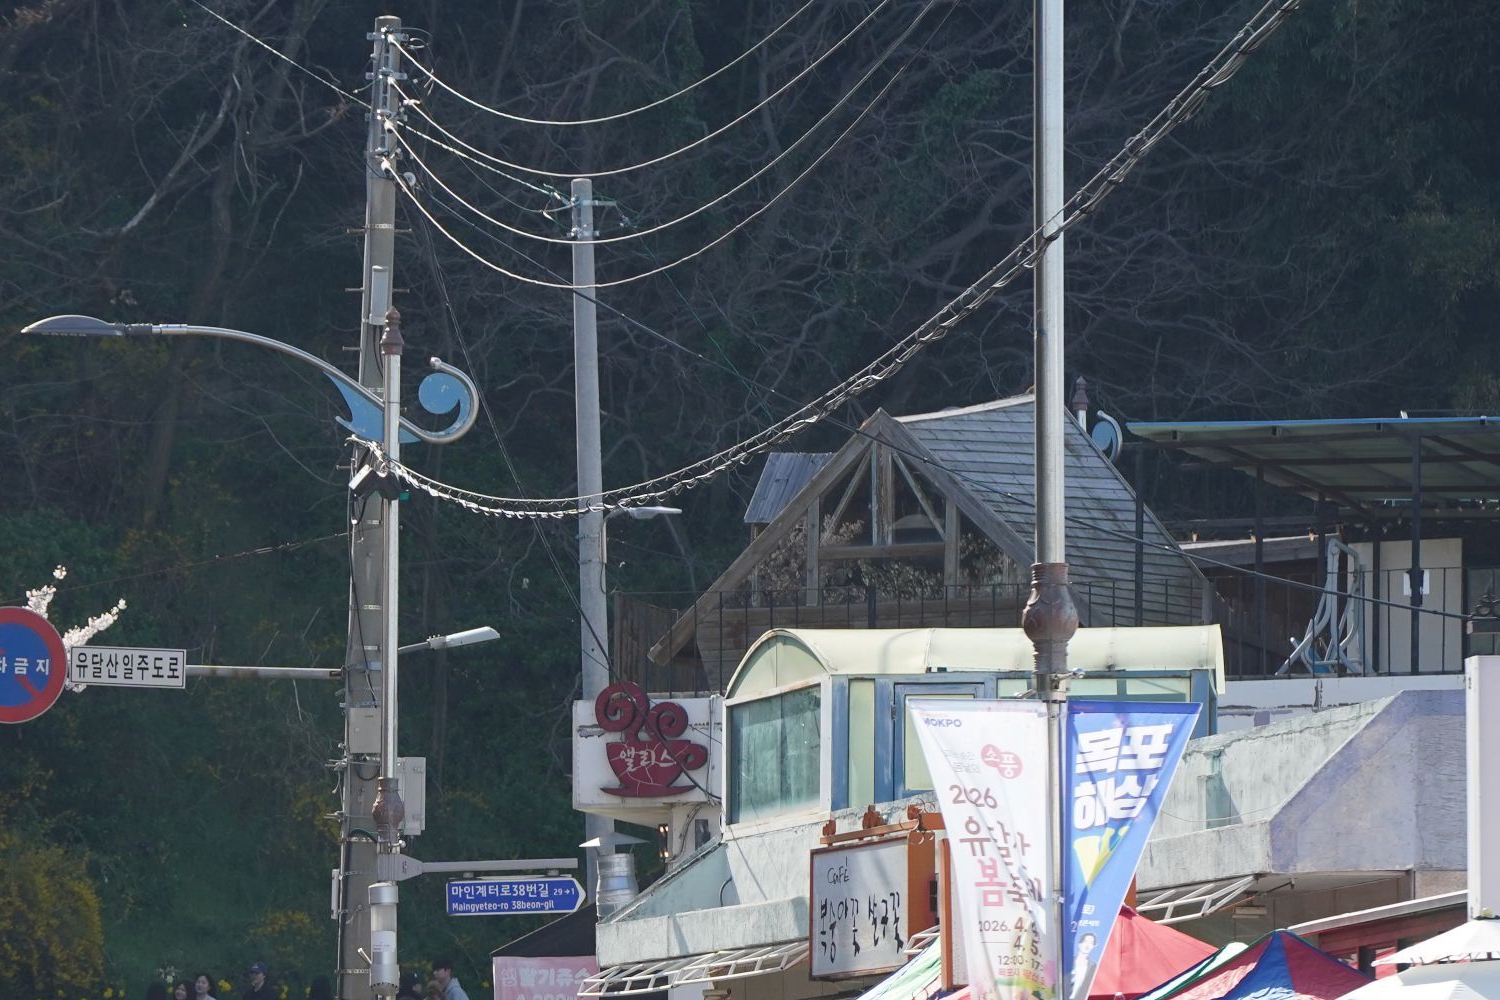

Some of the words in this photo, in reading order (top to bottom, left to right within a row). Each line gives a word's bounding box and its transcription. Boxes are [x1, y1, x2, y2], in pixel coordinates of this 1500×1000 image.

[75, 651, 180, 680] 유달산일주도로
[619, 748, 677, 772] 앨리스
[984, 745, 1019, 779] 소풍
[1076, 723, 1173, 774] 목포
[1074, 774, 1159, 830] 해상
[451, 883, 549, 900] 마인계터로38번길
[553, 888, 563, 896] 29
[452, 901, 509, 913] Maingyeteo-ro
[512, 899, 555, 911] 38beon-gil
[868, 891, 904, 955] 살구꽃
